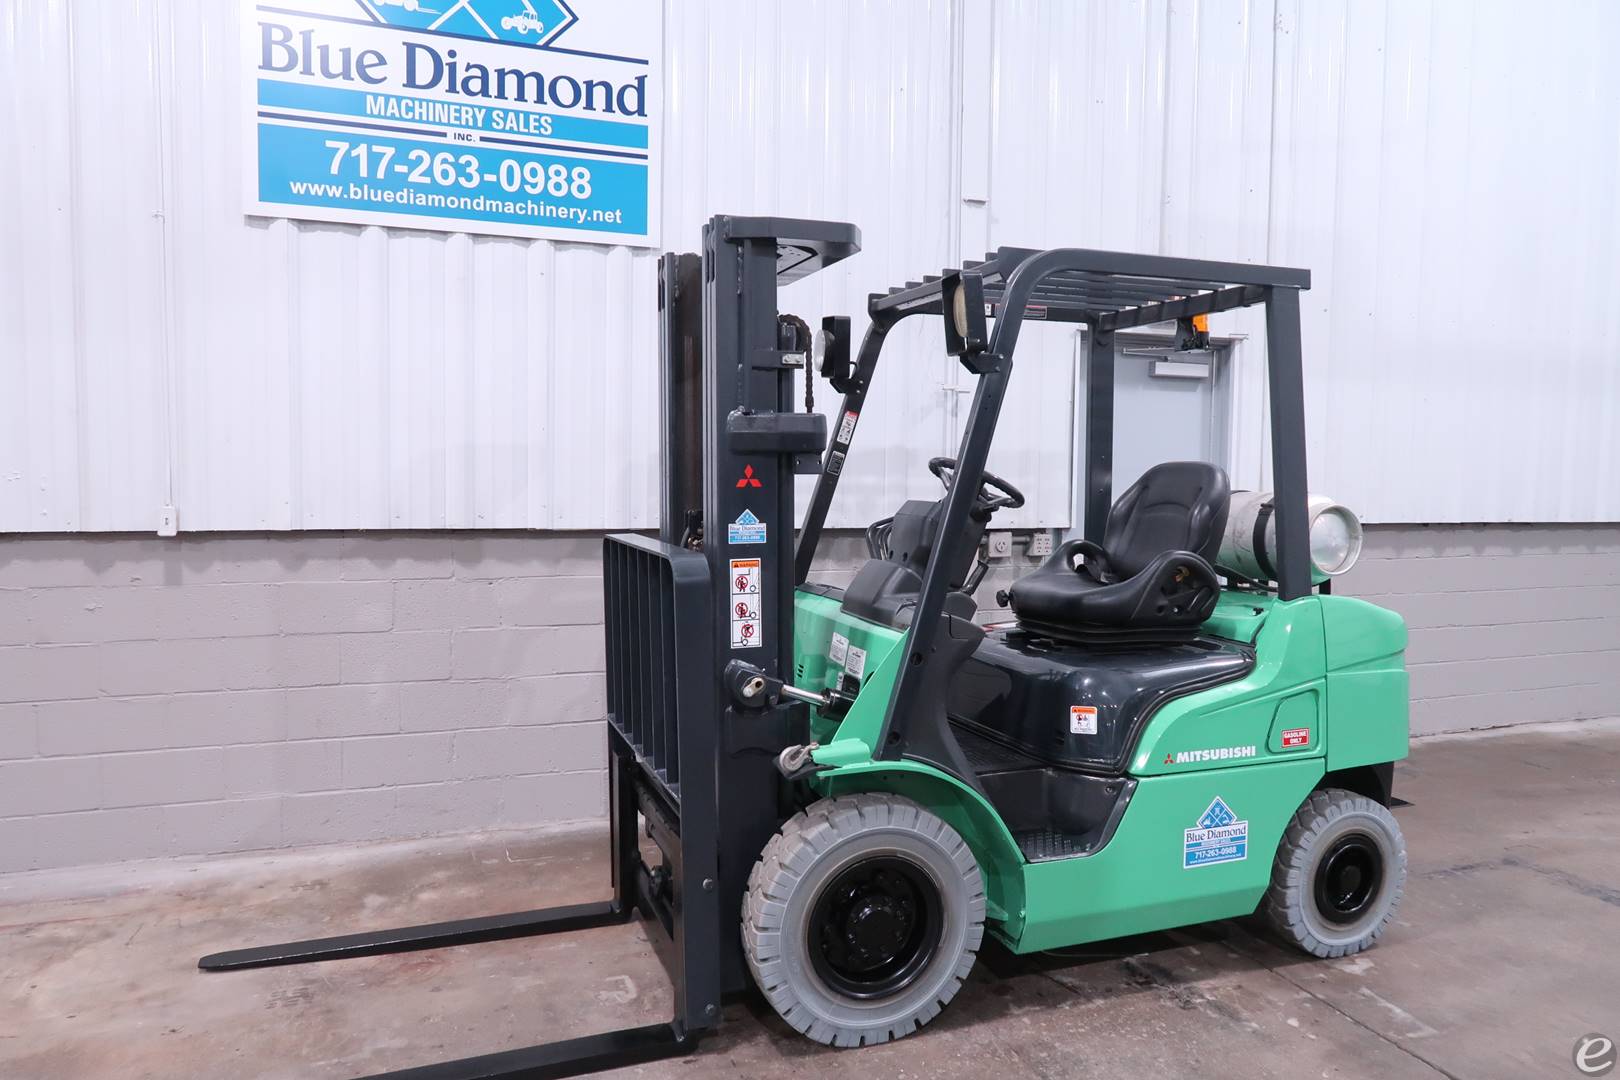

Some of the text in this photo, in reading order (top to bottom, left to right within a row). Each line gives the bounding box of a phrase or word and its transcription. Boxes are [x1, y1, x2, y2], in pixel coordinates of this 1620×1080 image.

[257, 22, 648, 117] Blue Diamond
[365, 95, 553, 136] MACHINERY SALES
[453, 131, 476, 142] INC.
[325, 140, 592, 200] 717-263-0988
[289, 180, 623, 224] www.bluediamondmachinery.net
[1176, 746, 1256, 763] MITSUBISHI
[1186, 825, 1246, 842] Blue Diamond
